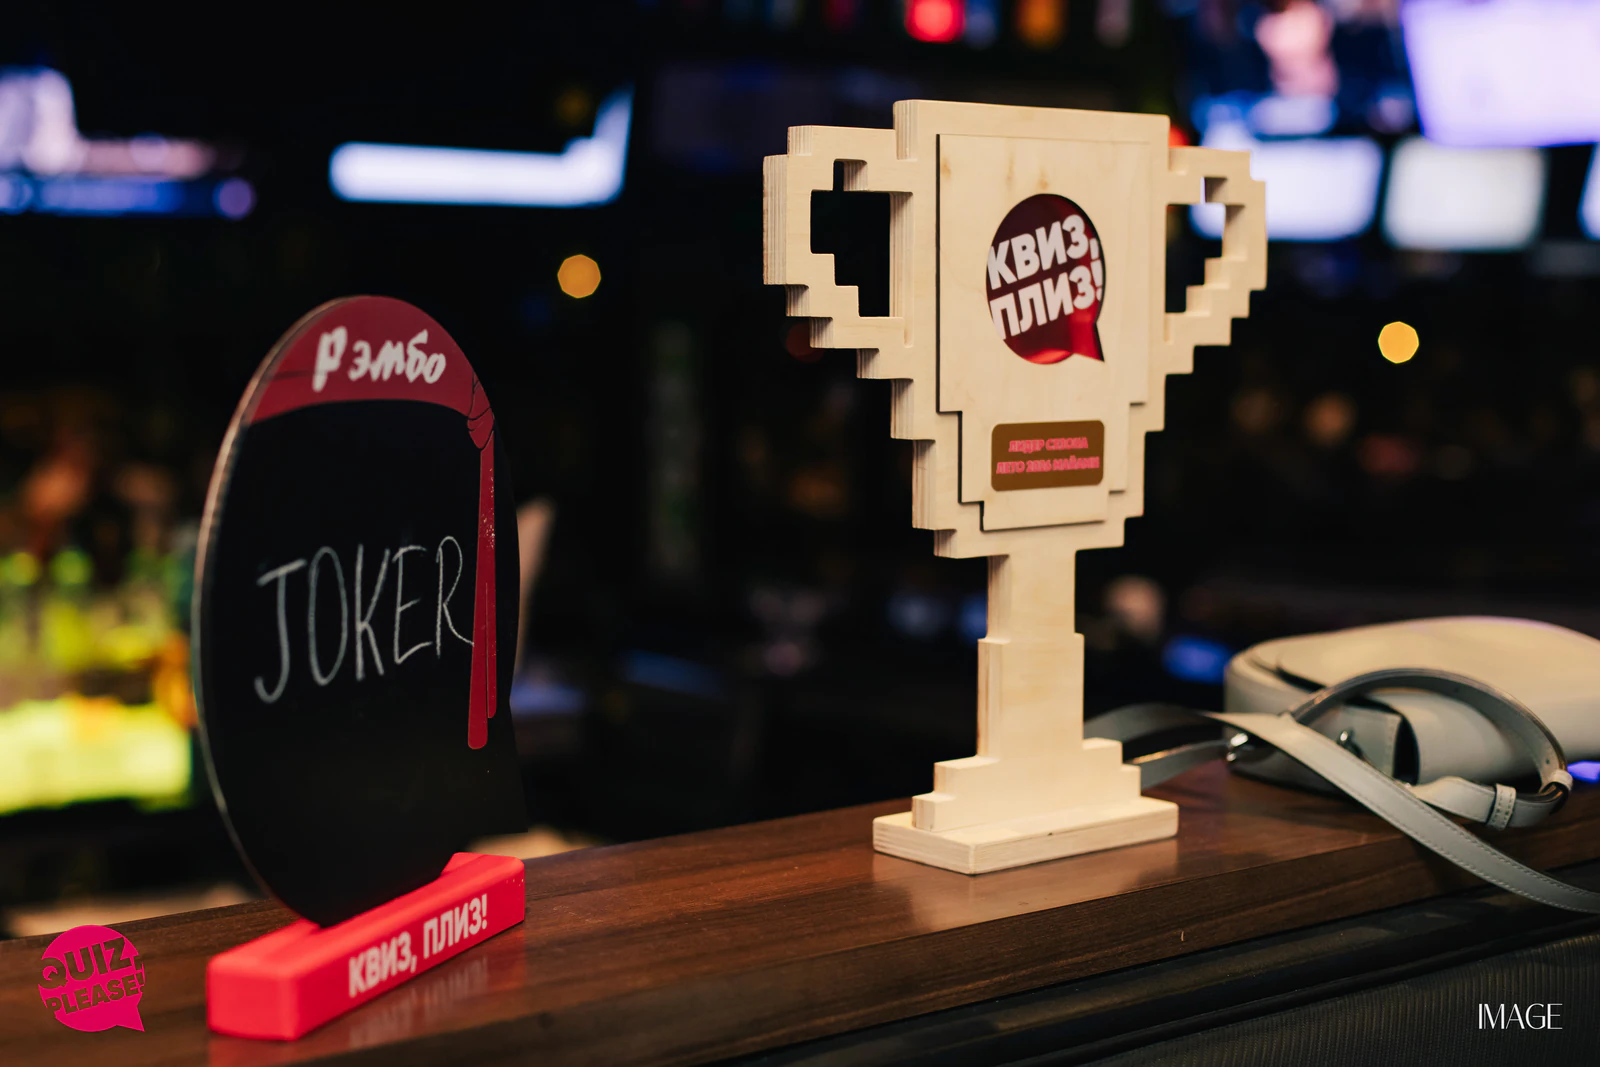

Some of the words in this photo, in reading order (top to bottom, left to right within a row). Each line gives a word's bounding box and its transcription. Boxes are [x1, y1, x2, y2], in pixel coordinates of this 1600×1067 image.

[987, 214, 1099, 290] КВИЗ,
[990, 259, 1103, 340] ПЛИЗ!
[996, 460, 1025, 474] ЛЕТО
[1008, 438, 1045, 454] ЛИДЕР
[254, 535, 475, 704] JOKER
[348, 930, 417, 998] КВИЗ,
[423, 893, 488, 959] ПЛИЗ!
